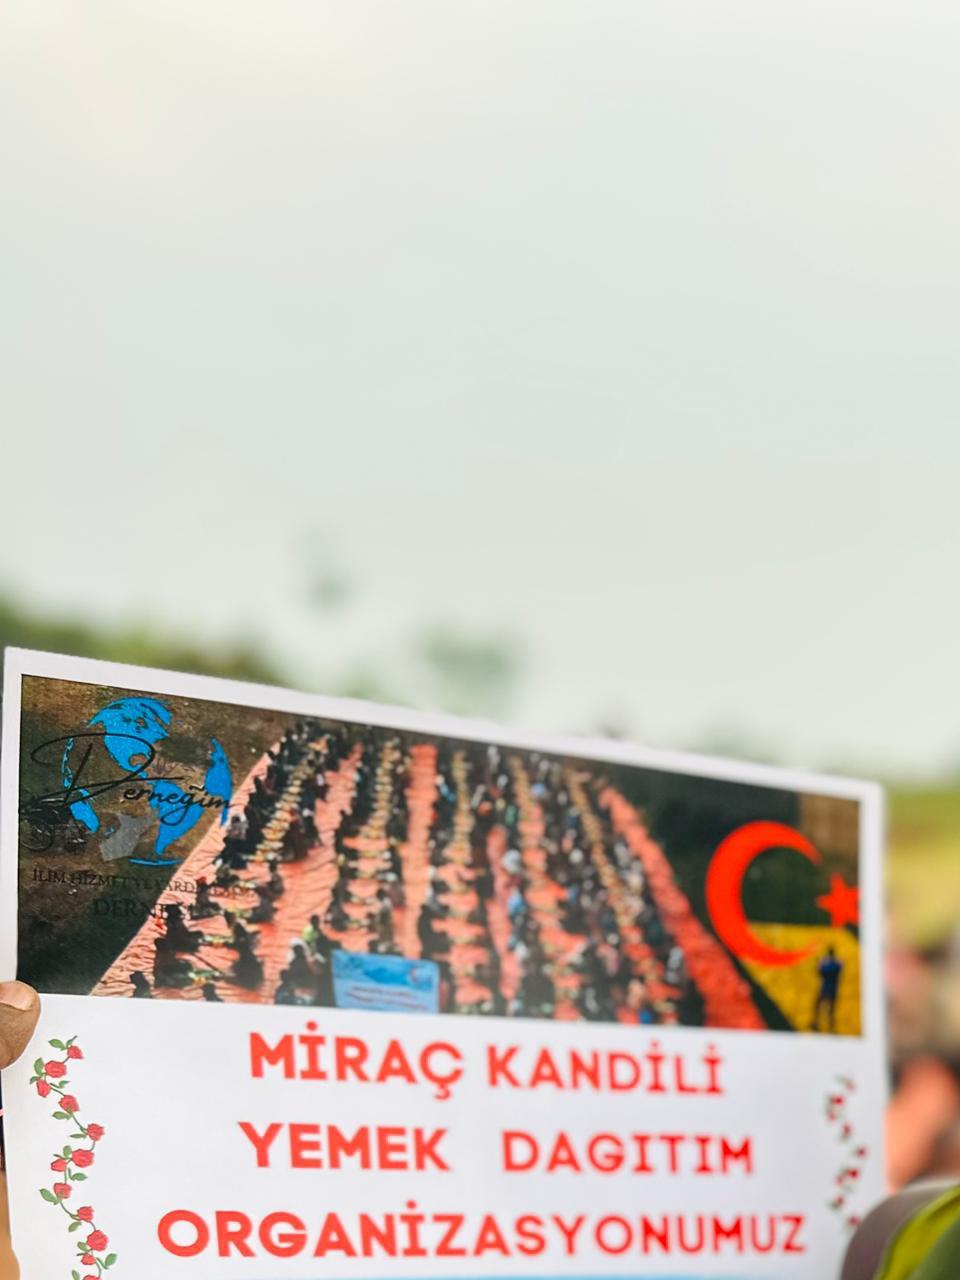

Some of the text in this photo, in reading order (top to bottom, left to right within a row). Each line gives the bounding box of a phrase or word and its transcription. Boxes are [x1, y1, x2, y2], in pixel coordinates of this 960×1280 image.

[250, 1020, 724, 1101] MİRAÇ KANDİLİ
[239, 1120, 754, 1176] YEMEK DAGITIM
[156, 1200, 806, 1259] ORGANİZASYONUMUZ
